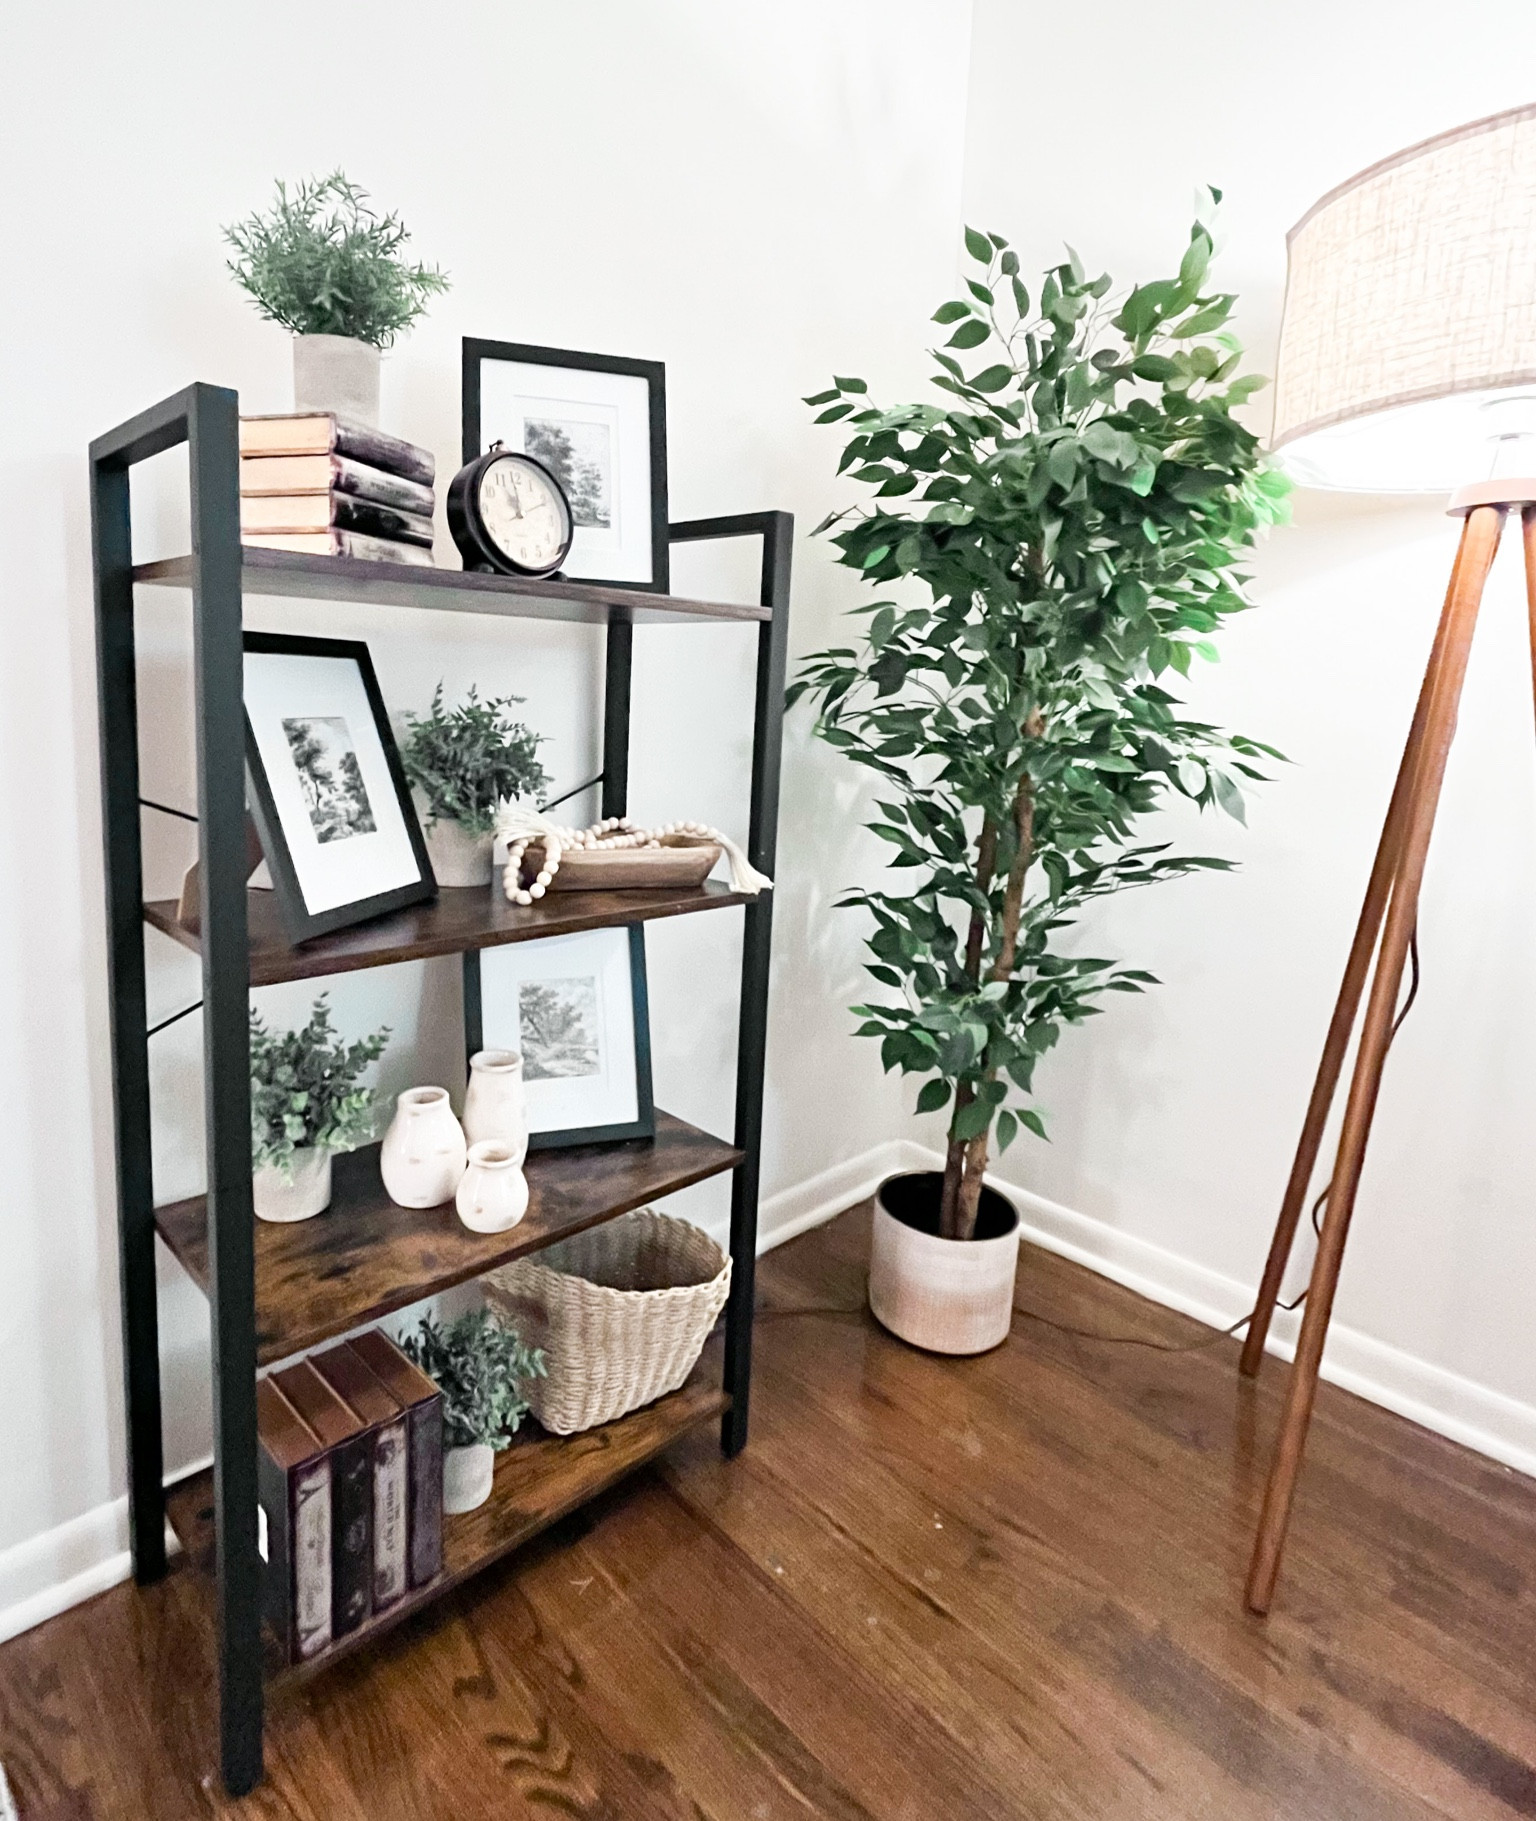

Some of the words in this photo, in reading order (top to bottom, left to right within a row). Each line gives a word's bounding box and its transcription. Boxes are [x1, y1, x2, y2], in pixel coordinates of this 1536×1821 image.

[495, 472, 506, 488] 11
[485, 485, 496, 499] 10
[503, 538, 510, 552] 7
[535, 544, 542, 558] 5
